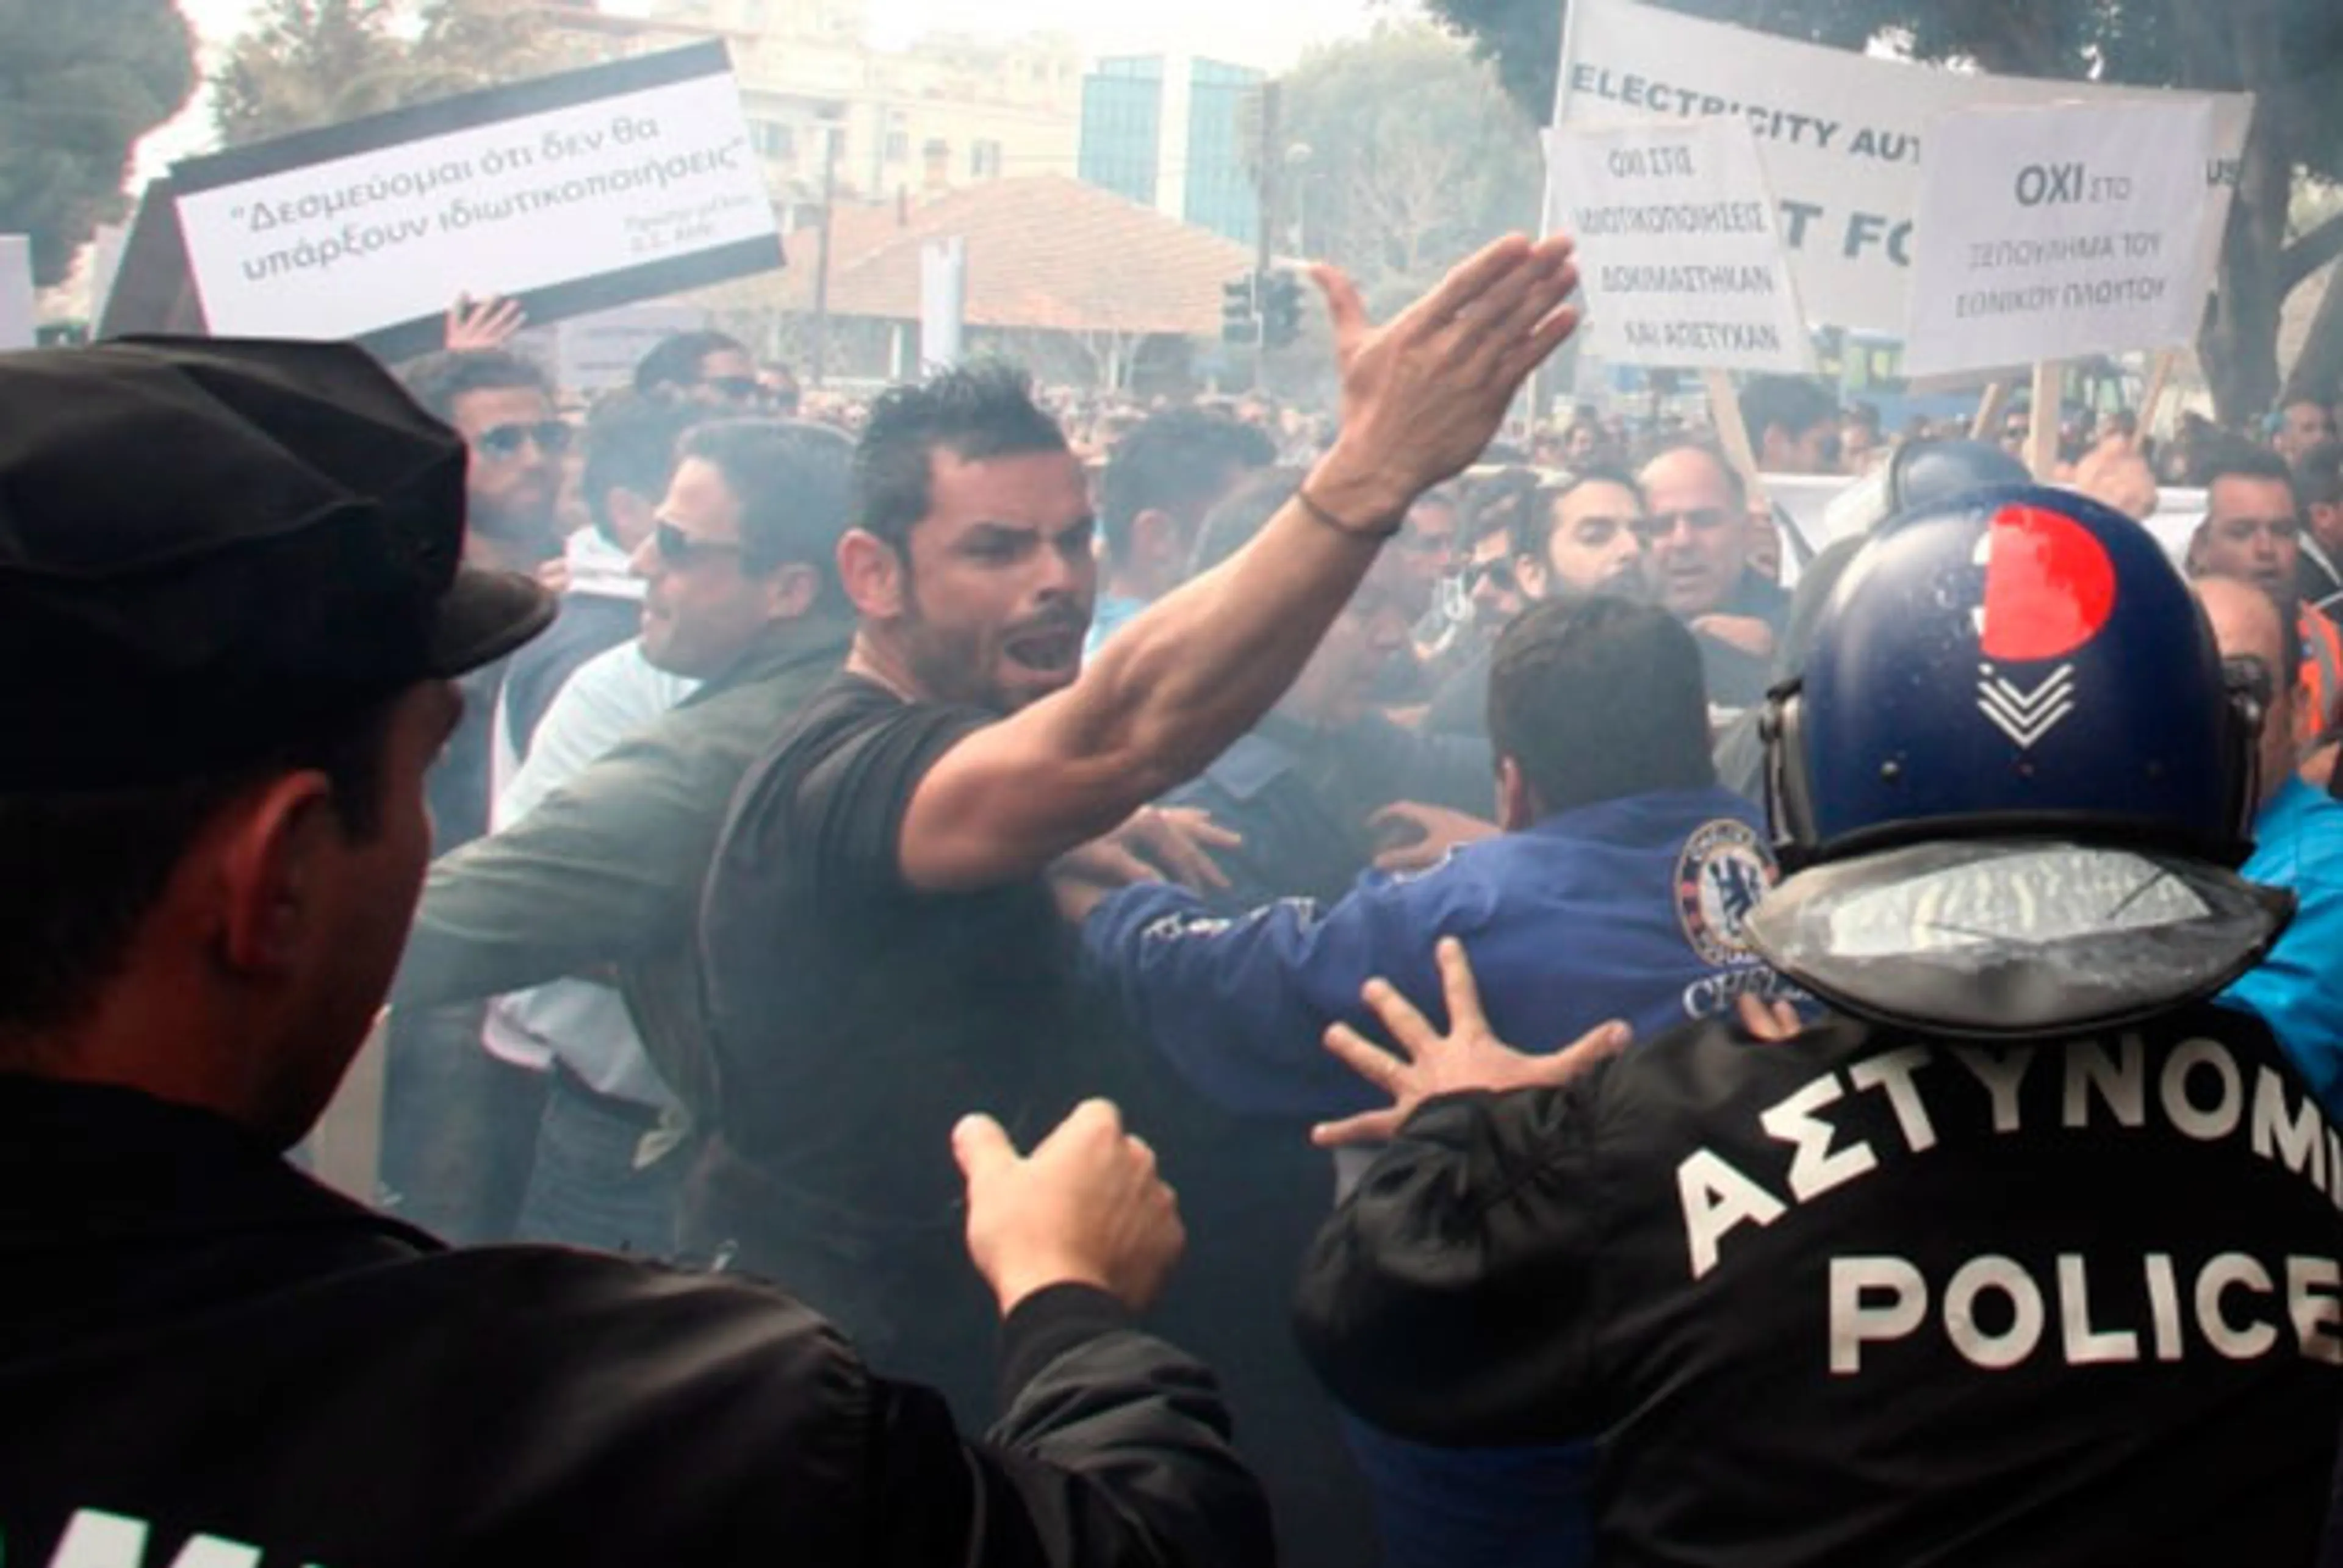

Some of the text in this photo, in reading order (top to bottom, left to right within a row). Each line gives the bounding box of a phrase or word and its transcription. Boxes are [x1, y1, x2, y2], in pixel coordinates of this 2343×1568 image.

[480, 146, 533, 176] ότι
[541, 129, 604, 162] δεν
[611, 115, 660, 145] θα
[2015, 162, 2132, 206] ΟΧΙ ΣΤΟ
[243, 216, 430, 281] υπάρξουν
[1830, 1253, 2343, 1374] POLICE
